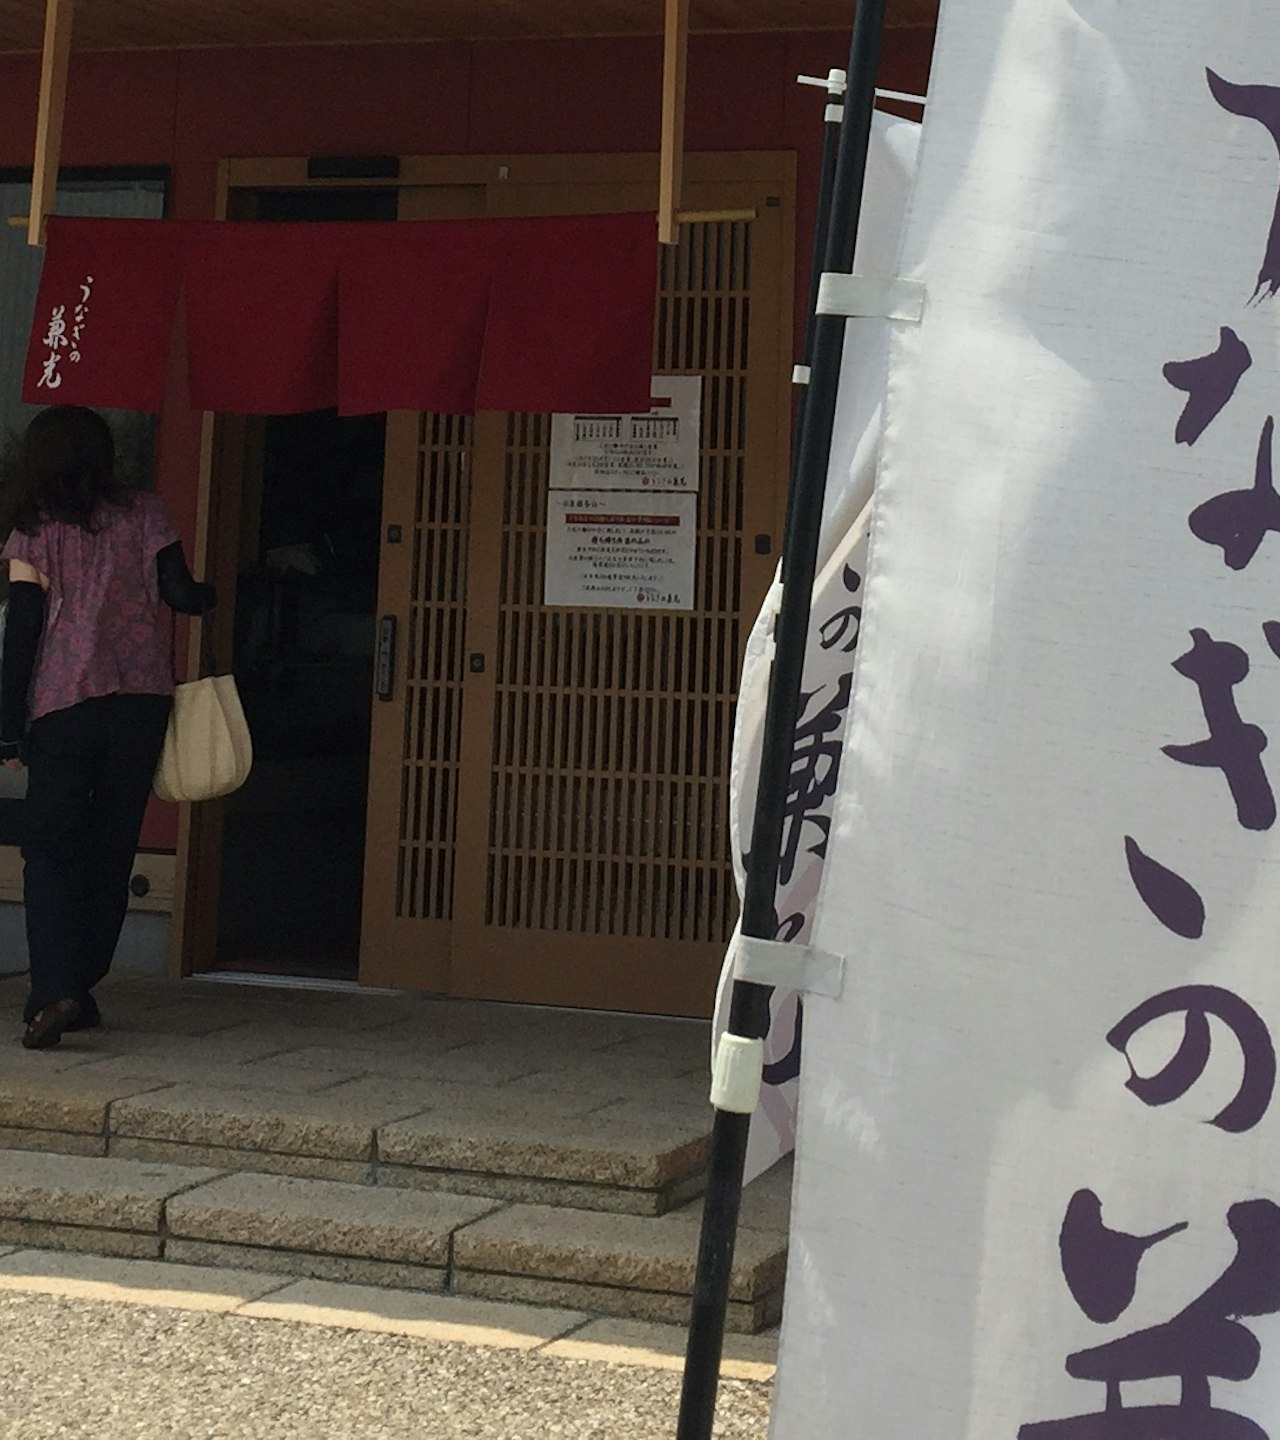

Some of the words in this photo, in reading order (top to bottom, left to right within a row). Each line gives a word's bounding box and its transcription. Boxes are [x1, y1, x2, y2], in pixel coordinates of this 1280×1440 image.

[36, 305, 68, 389] 兼光
[69, 275, 95, 363] うなぎの
